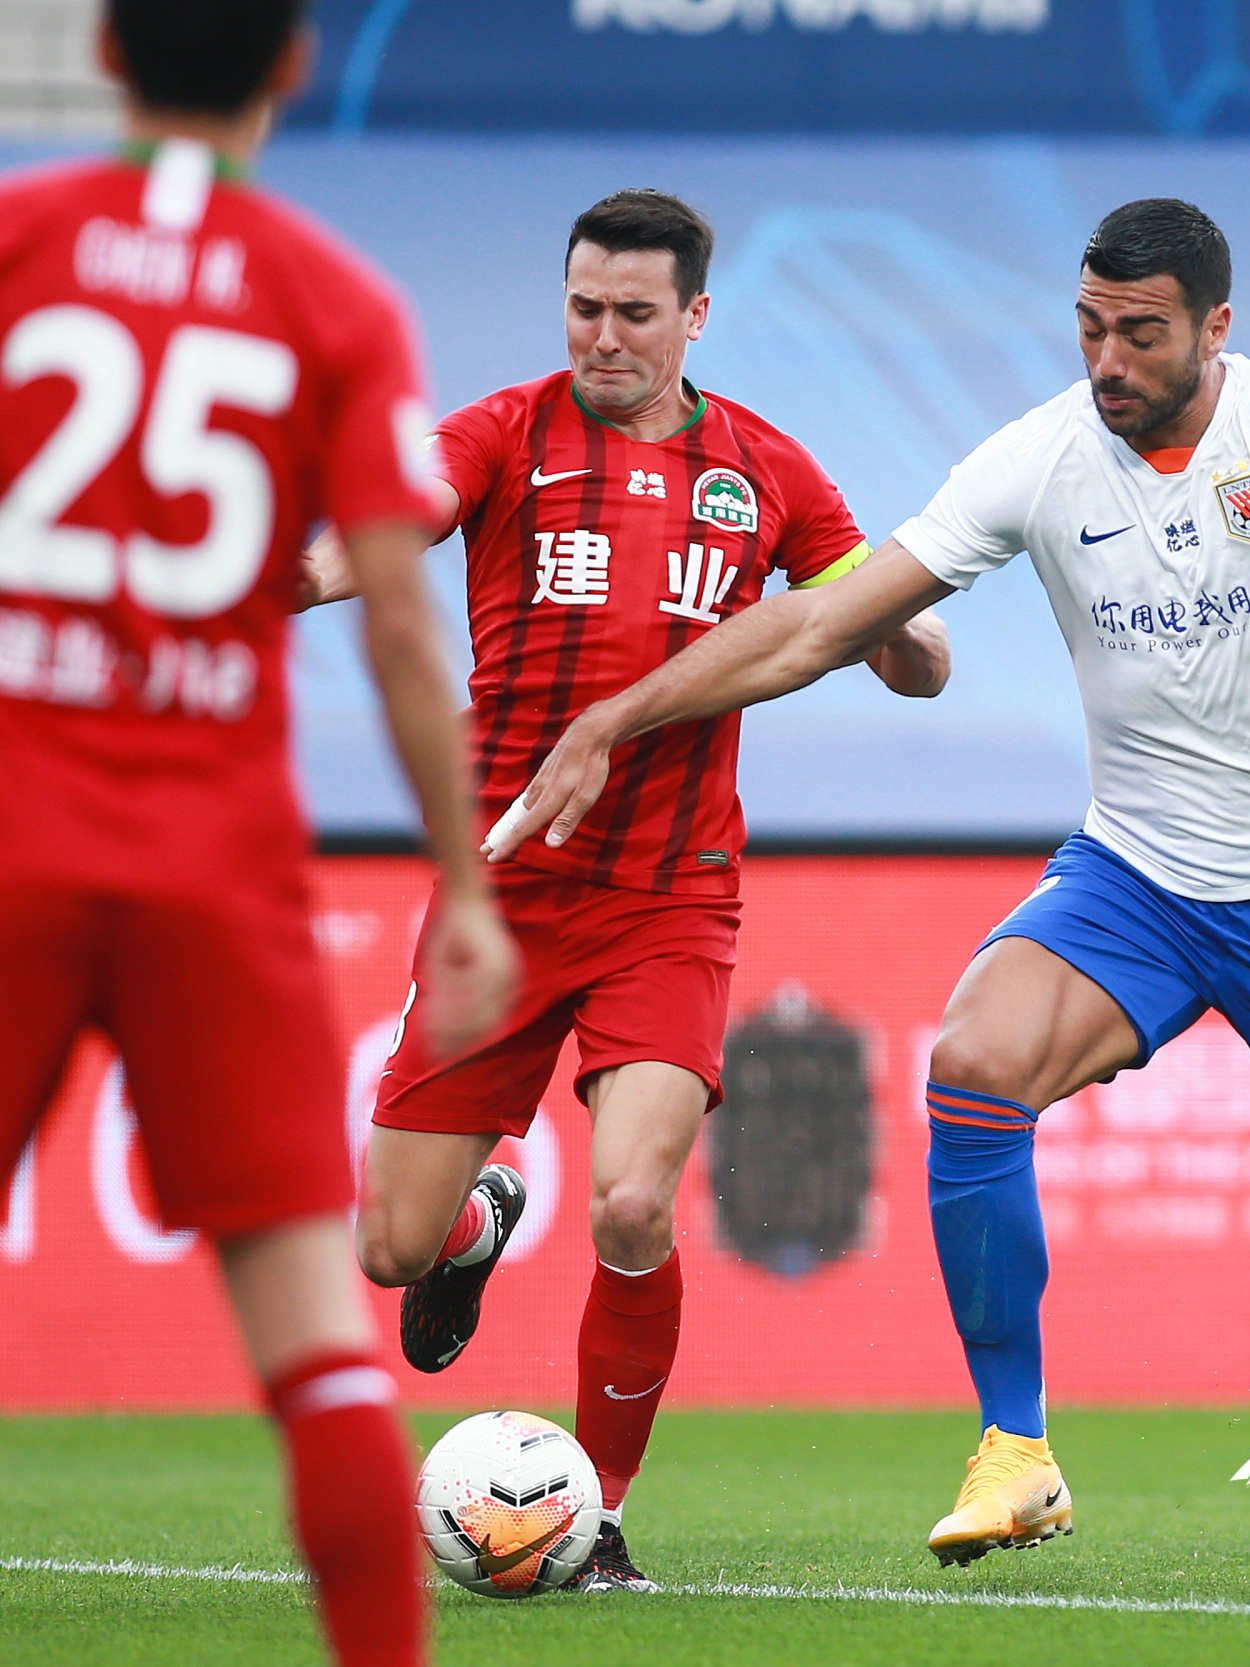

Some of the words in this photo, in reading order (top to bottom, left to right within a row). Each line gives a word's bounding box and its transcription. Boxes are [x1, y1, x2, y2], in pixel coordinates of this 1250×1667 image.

[0, 300, 300, 620] 25
[531, 529, 738, 624] 建业
[1098, 636, 1137, 651] Your
[1147, 637, 1203, 653] Power
